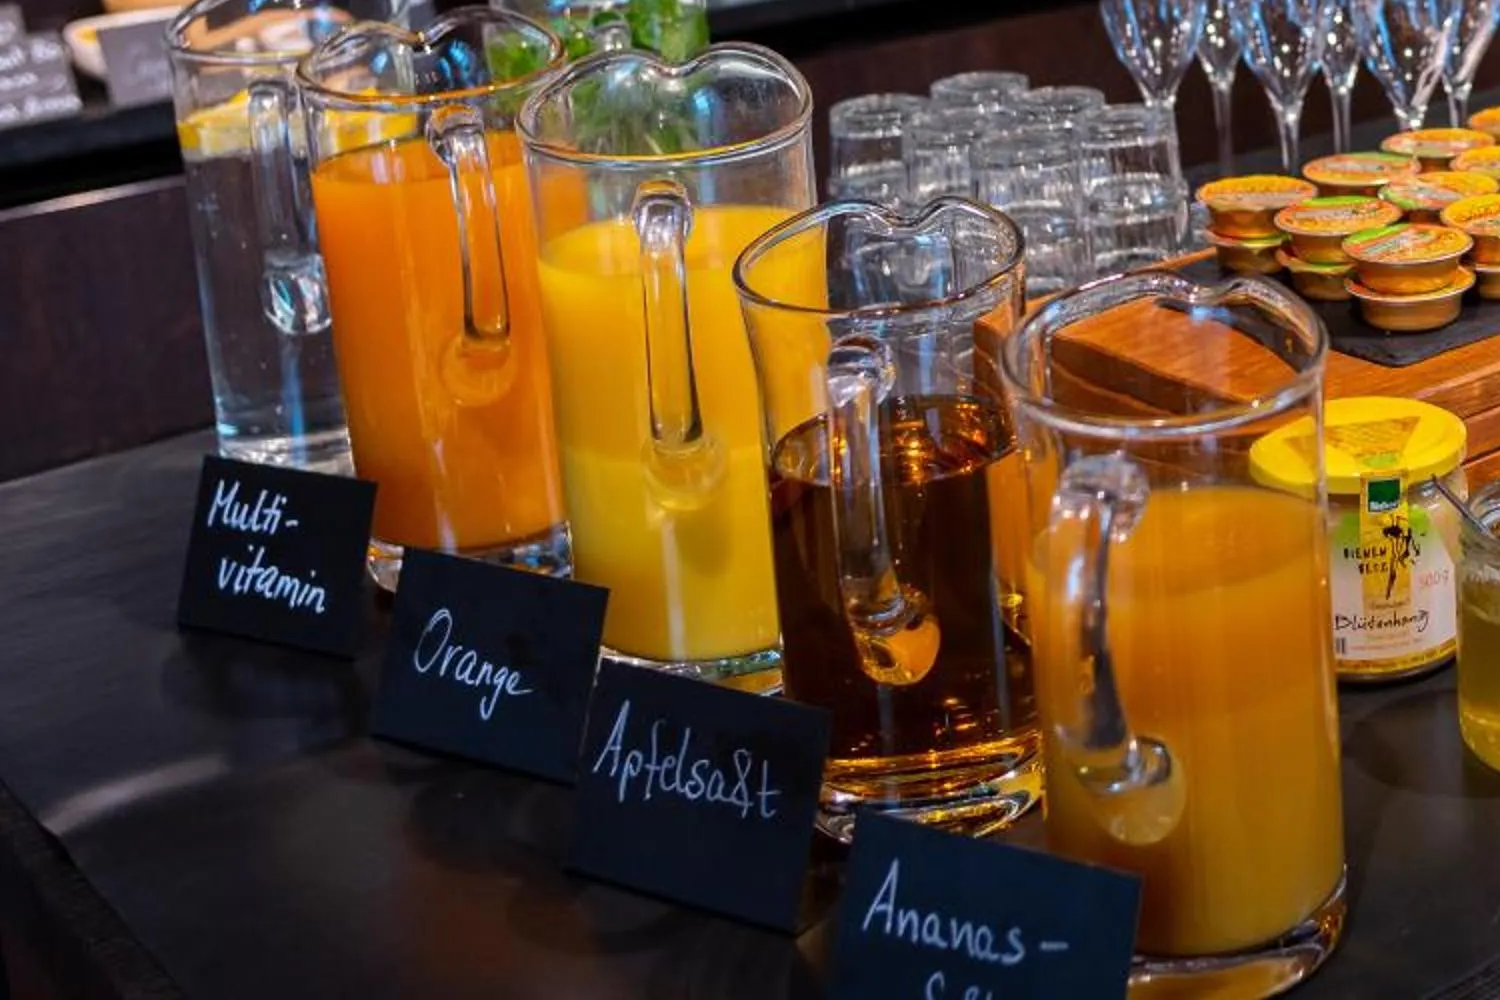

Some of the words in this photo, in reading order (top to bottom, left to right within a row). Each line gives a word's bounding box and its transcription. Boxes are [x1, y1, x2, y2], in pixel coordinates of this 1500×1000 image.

[207, 479, 299, 535] Multi-
[218, 545, 326, 613] vitamin
[413, 607, 534, 721] Orange
[861, 857, 1070, 965] Ananas-
